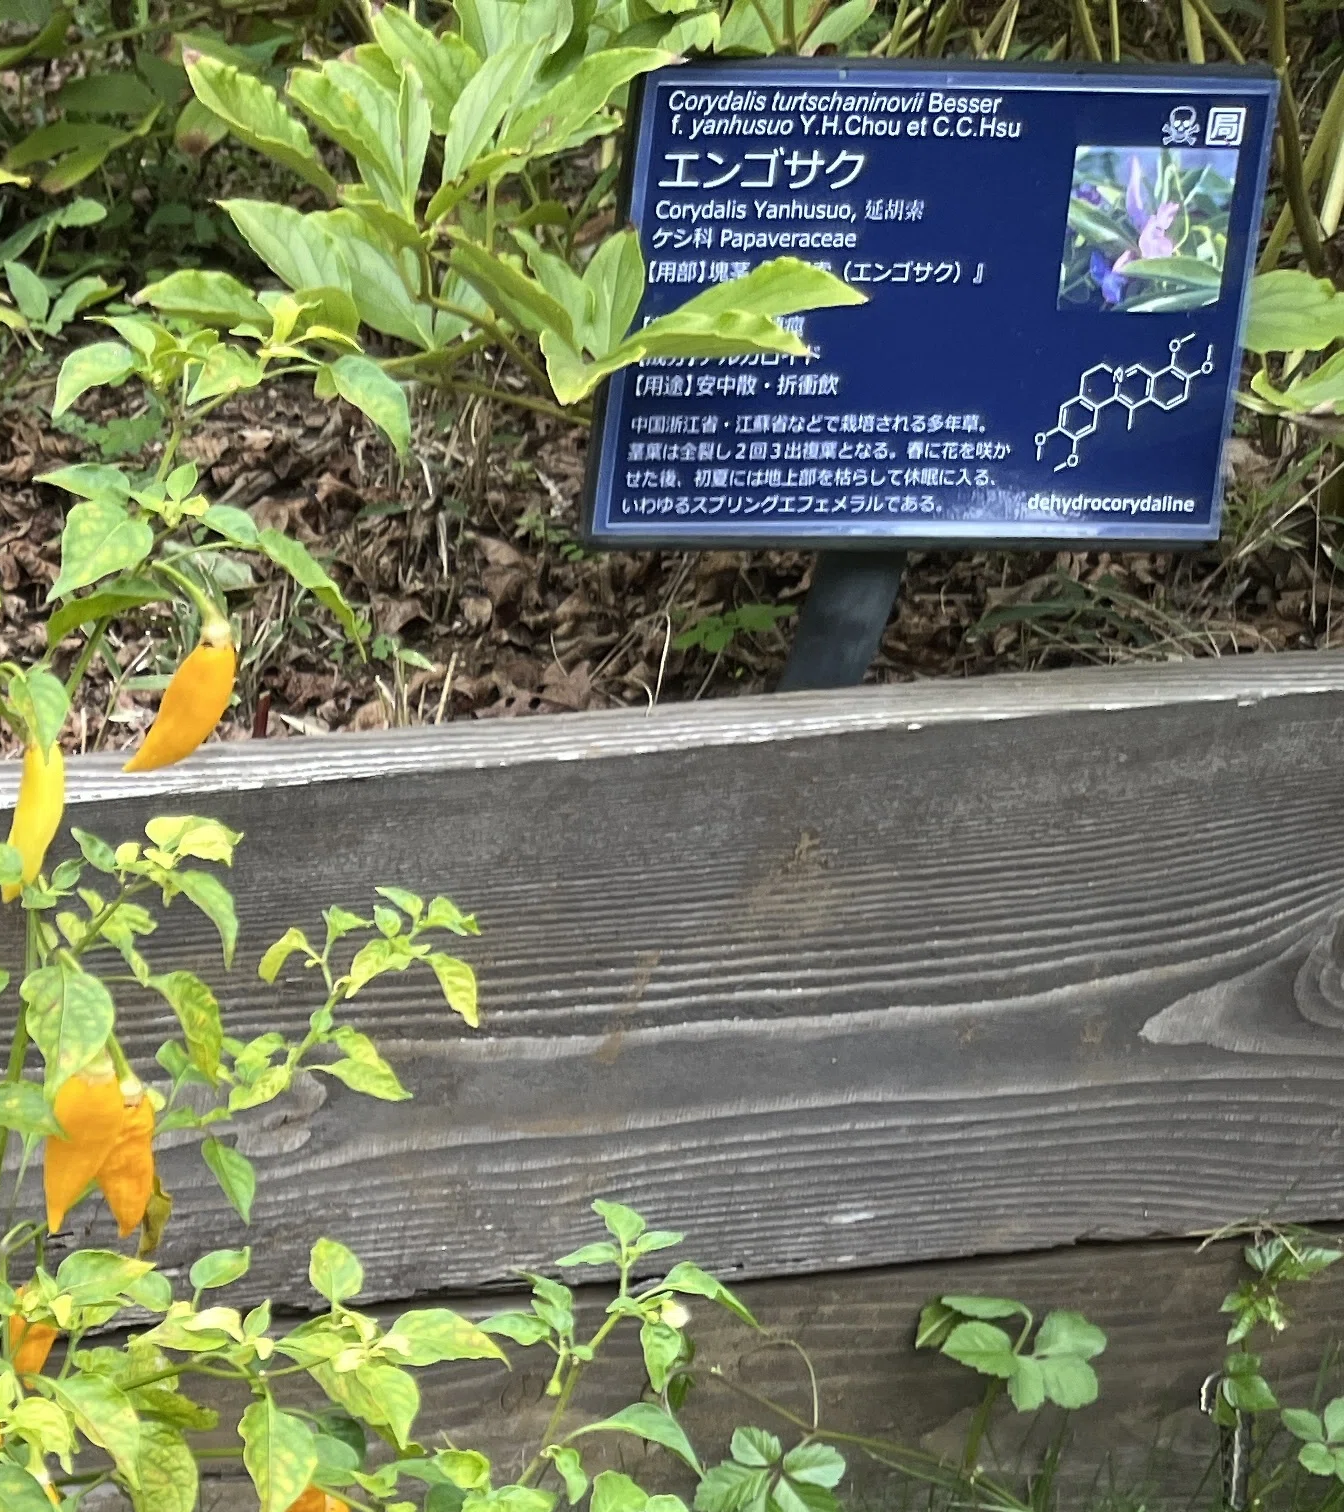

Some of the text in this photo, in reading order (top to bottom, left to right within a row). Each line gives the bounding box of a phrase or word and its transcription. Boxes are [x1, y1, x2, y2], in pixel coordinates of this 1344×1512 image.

[668, 90, 1002, 116] Corydalis turtschaninovii Besser
[671, 115, 1021, 139] f. yanhusuo Y.H.Chou et C.C.Hsu
[1208, 110, 1242, 143] 局
[657, 146, 866, 190] エンゴサク
[655, 200, 747, 222] Corydalis
[754, 199, 857, 224] Yanhusuo,
[651, 227, 857, 252] ケシ科 Papaveraceae
[1028, 493, 1195, 515] dehydrocorydaline
